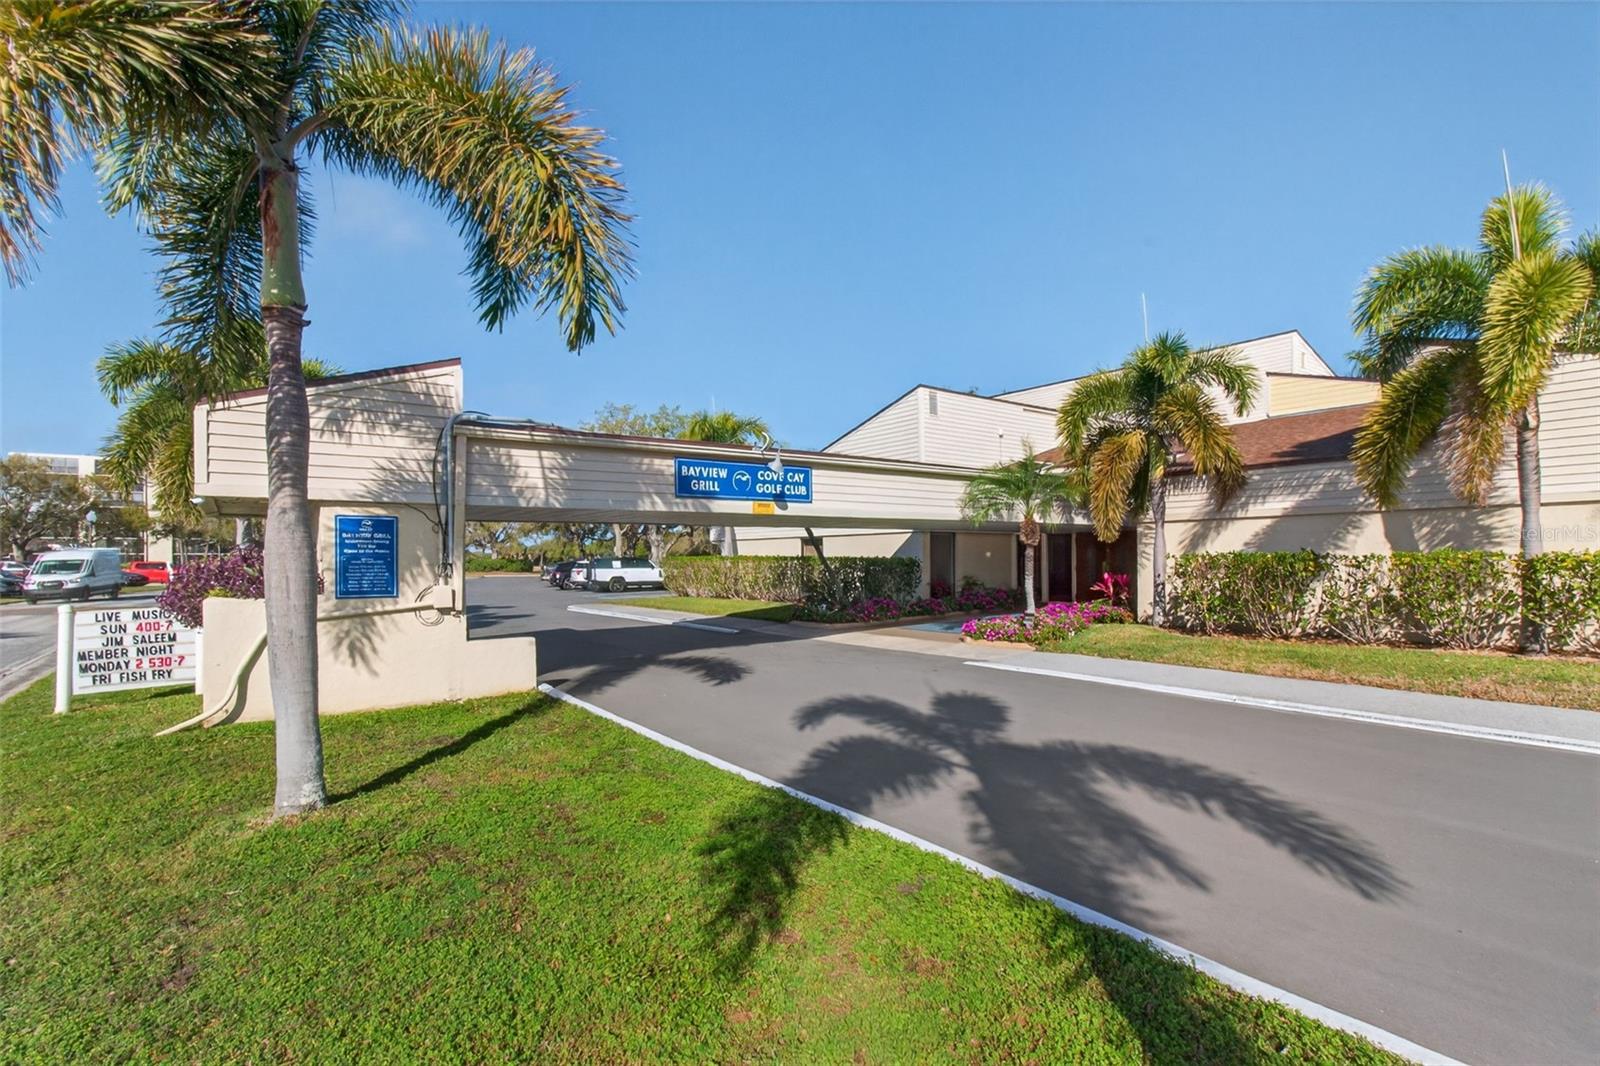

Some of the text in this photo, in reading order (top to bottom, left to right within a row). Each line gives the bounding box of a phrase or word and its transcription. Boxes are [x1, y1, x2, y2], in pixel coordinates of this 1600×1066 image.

[681, 465, 727, 478] BAYVIEW
[757, 470, 805, 483] COVE CAY
[691, 480, 719, 491] GRILL
[756, 483, 807, 495] GOLF CLUB
[95, 609, 171, 622] LIVE MUSIC
[100, 624, 127, 635] SUN
[102, 633, 177, 647] JIM SALEEM
[77, 644, 174, 661] MEMBER NIGHT
[79, 660, 130, 673] MONDAY
[92, 669, 173, 685] FRI FISH FRY
